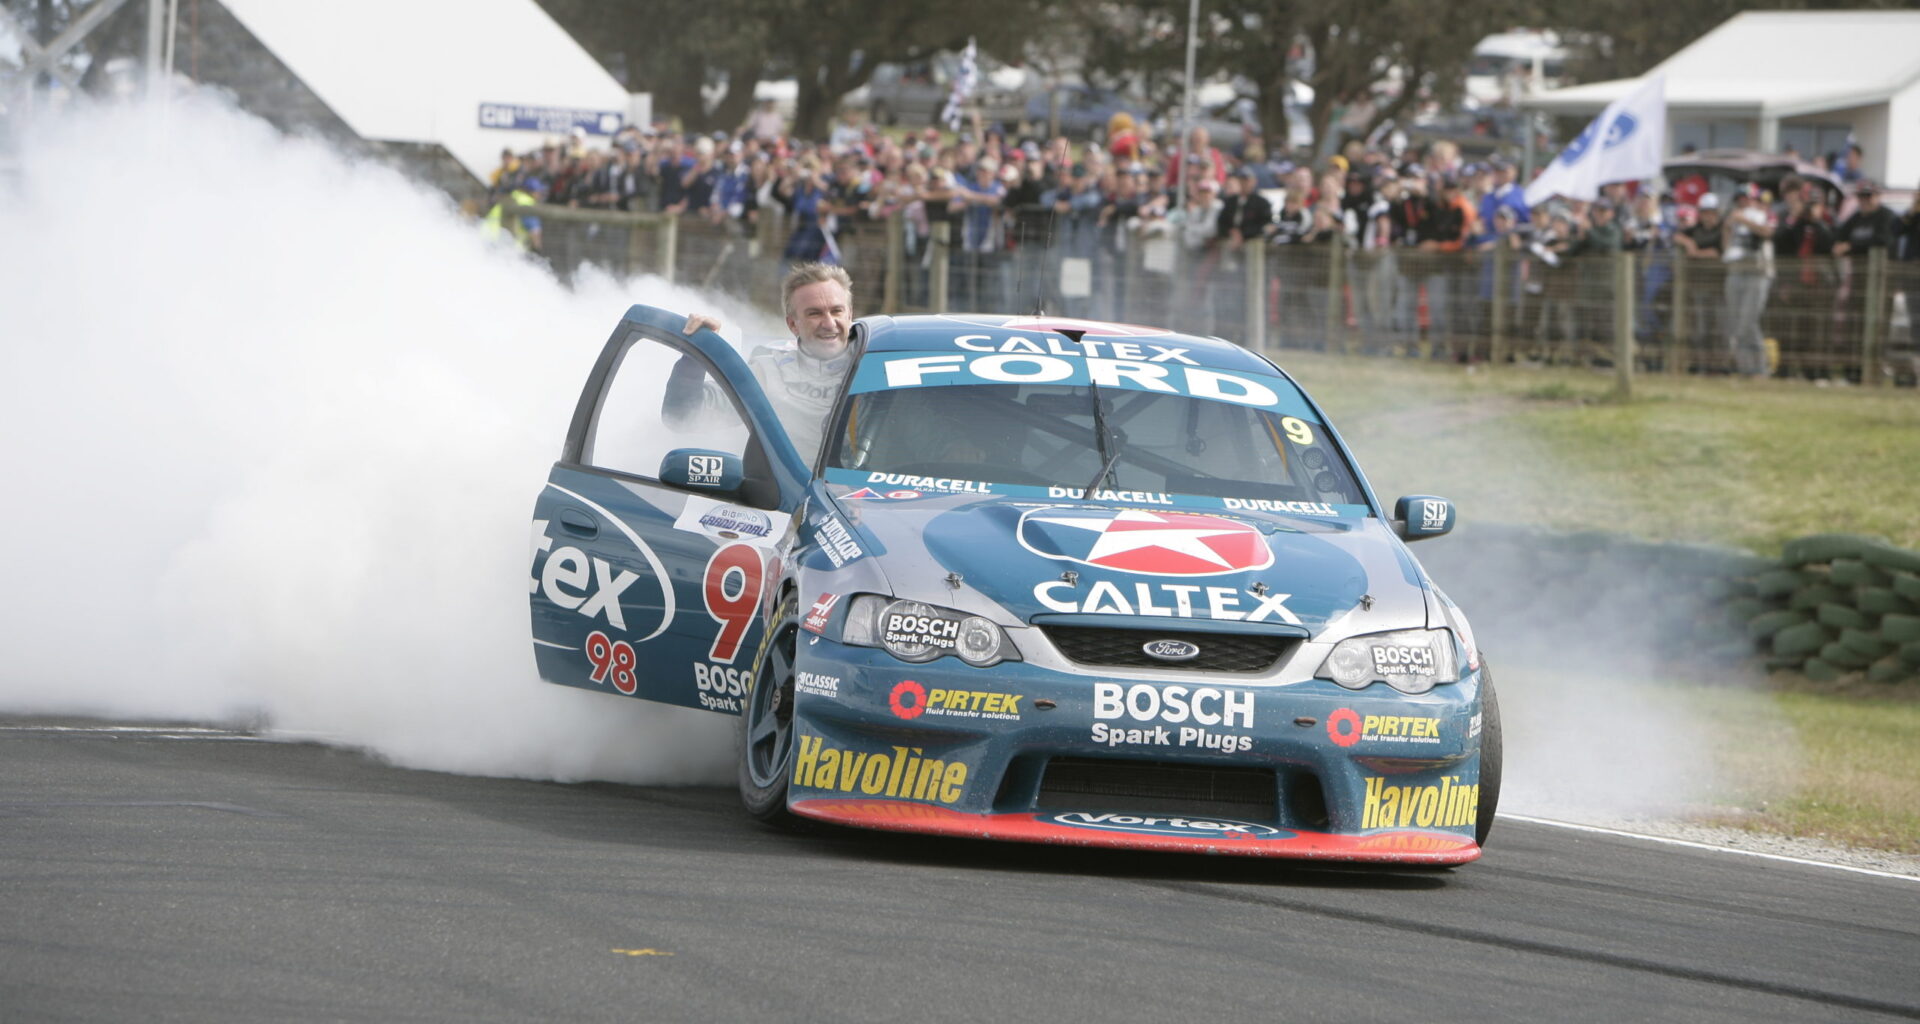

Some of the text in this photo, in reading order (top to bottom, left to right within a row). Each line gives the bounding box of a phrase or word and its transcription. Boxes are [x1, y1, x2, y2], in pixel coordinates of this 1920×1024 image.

[953, 334, 1200, 366] CALTEX
[884, 354, 1279, 407] FORD
[1281, 416, 1313, 445] 9
[690, 457, 722, 475] SP
[689, 474, 720, 484] SP AIR
[867, 471, 990, 493] DURACELL
[1223, 497, 1338, 516] DURACELL
[1424, 502, 1446, 520] SP
[698, 514, 734, 530] GRAND
[821, 517, 863, 561] DUNLOP
[702, 543, 766, 664] 9
[1033, 581, 1303, 625] CALTEX
[888, 614, 959, 638] BOSCH
[885, 631, 955, 649] Spark Plugs
[1156, 642, 1187, 655] Ford
[585, 631, 637, 696] 98
[1373, 647, 1434, 665] BOSCH
[1376, 664, 1435, 677] Spark Plugs
[805, 673, 840, 691] CLASSIC
[699, 691, 738, 712] Spark
[926, 688, 1024, 714] PIRTEK
[1094, 682, 1255, 728] BOSCH
[926, 707, 1021, 721] fluid transfer solutions
[1362, 715, 1440, 737] PIRTEK
[1091, 722, 1253, 753] Spark Plugs
[1361, 734, 1441, 744] fluid transfer solutions
[794, 734, 967, 804] Havoline
[1361, 776, 1478, 829] Havoline
[1073, 812, 1254, 833] Vortex
